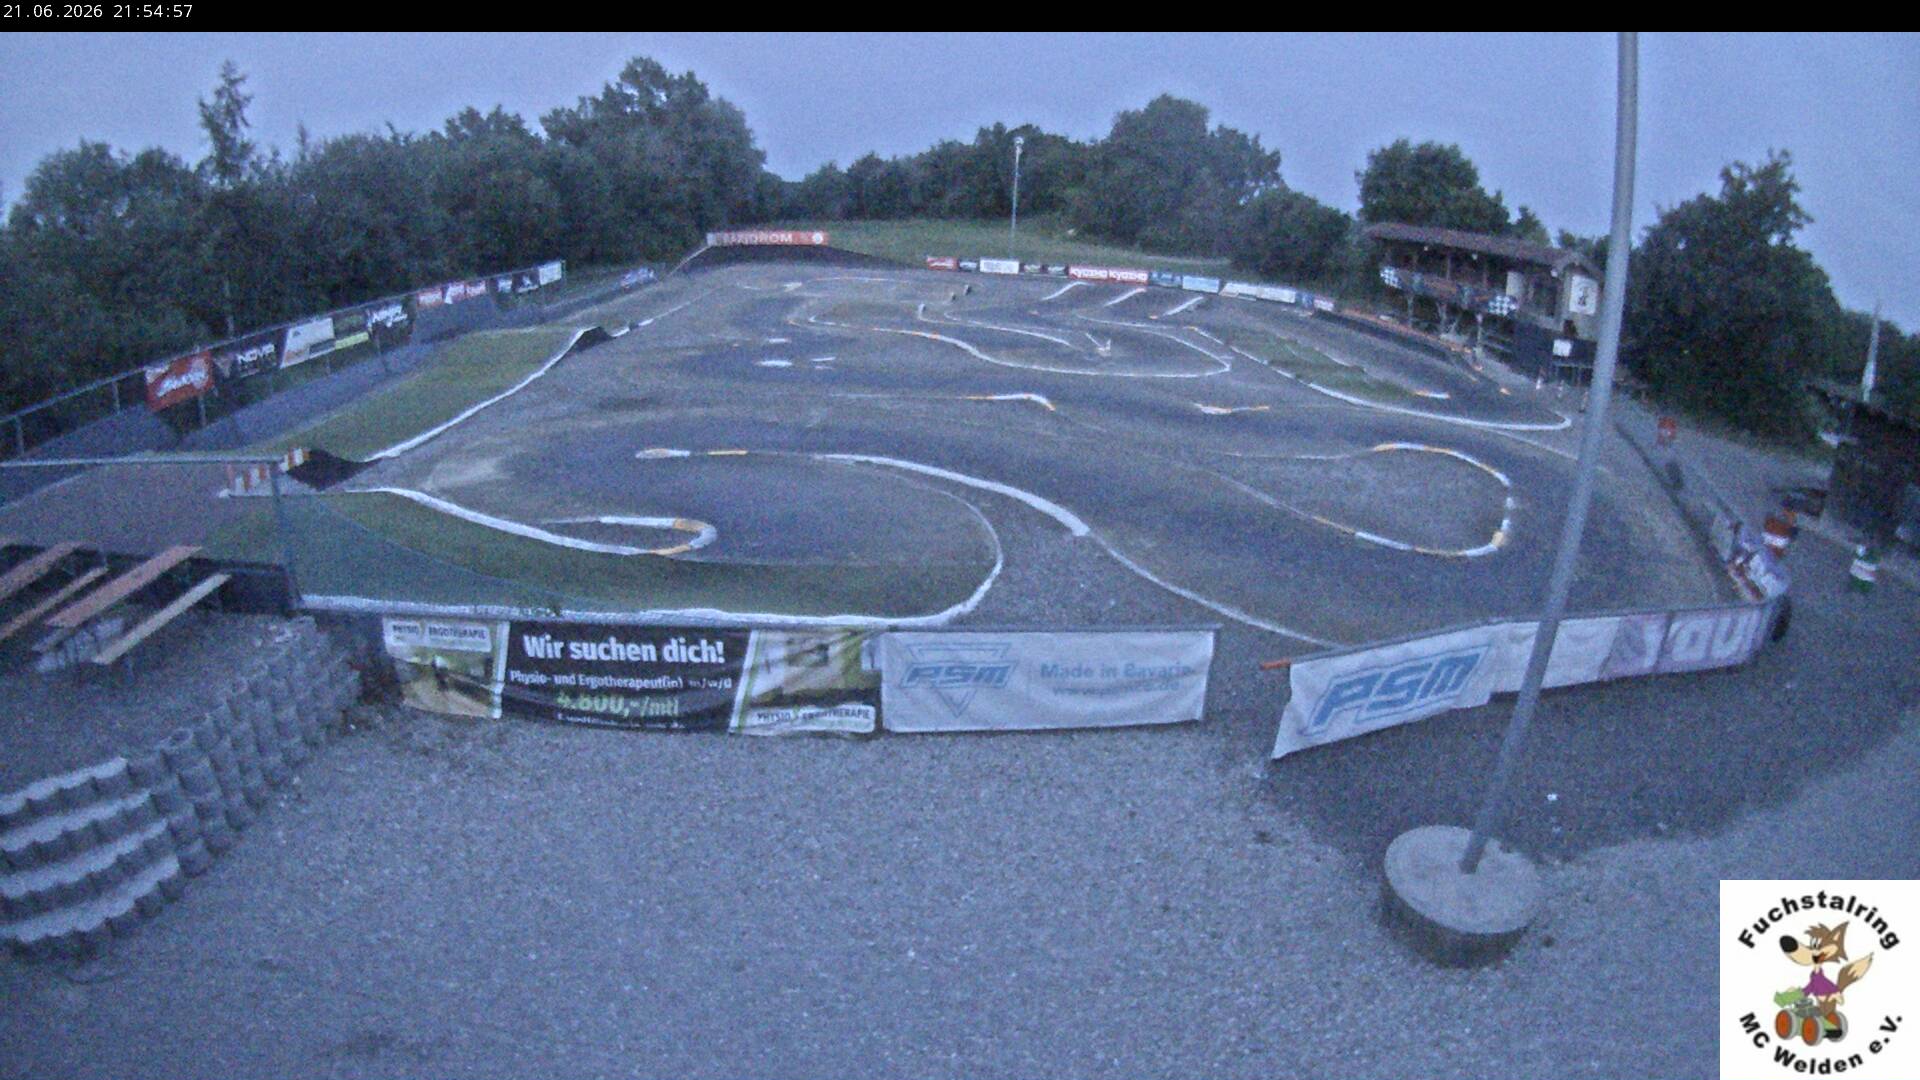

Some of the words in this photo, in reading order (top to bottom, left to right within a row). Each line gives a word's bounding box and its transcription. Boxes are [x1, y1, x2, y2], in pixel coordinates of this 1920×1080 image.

[523, 634, 564, 659] Wir
[569, 636, 657, 662] suchen
[663, 637, 725, 664] dich!
[509, 669, 551, 685] Physio-
[554, 673, 576, 686] und
[579, 674, 683, 690] Ergotherapeut(in)
[906, 666, 1011, 683] PSM
[1040, 663, 1093, 678] Made
[1102, 662, 1117, 678] in
[1312, 653, 1481, 727] PSM
